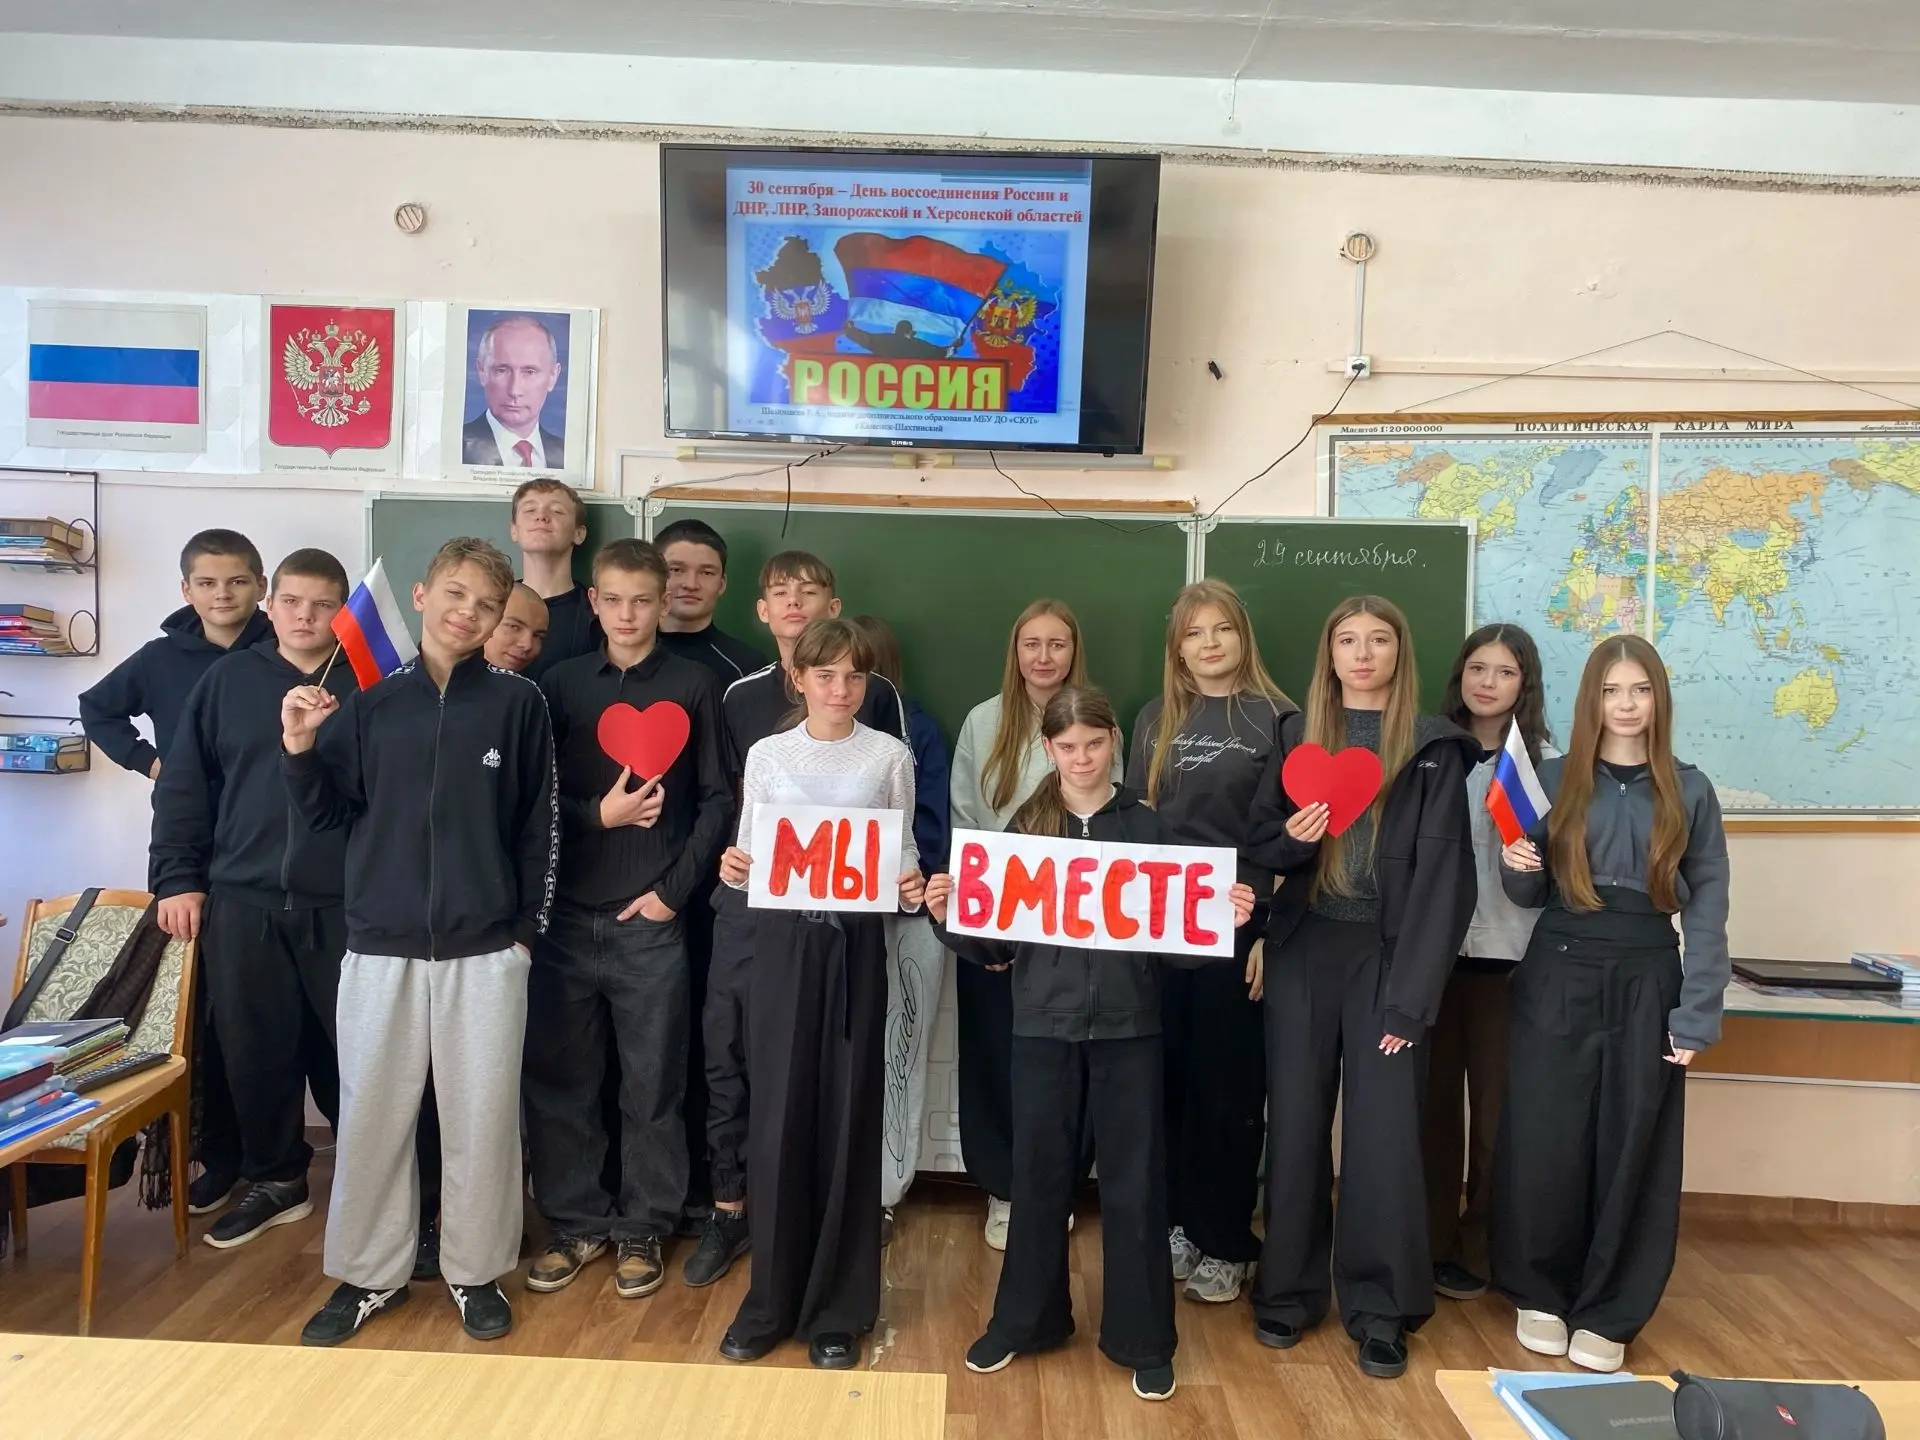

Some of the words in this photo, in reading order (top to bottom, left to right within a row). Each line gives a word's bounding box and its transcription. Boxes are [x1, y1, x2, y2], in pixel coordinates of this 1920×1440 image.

[747, 181, 764, 194] 30
[767, 183, 834, 199] сентября
[850, 183, 887, 199] День
[891, 187, 999, 201] воссоединения
[1004, 187, 1055, 201] России
[1060, 191, 1069, 201] и
[733, 201, 769, 217] ДНР,
[772, 202, 809, 218] ЛНР,
[812, 203, 908, 220] Запорожской
[913, 209, 921, 219] и
[926, 206, 1012, 223] Херсонской
[1017, 208, 1083, 223] областей
[794, 359, 1001, 410] РОССИЯ
[924, 413, 972, 424] образования
[973, 415, 993, 424] МБУ
[994, 416, 1008, 425] ДО
[1340, 426, 1378, 434] Масштаб
[1515, 421, 1649, 432] ПОЛИТИЧЕСКАЯ
[1674, 420, 1731, 431] КАРТА
[1745, 419, 1795, 430] МИРА
[1253, 539, 1287, 568] 29
[1294, 542, 1427, 572] сентября.
[768, 816, 880, 901] МЫ
[957, 841, 1219, 946] ВМЕСТЕ
